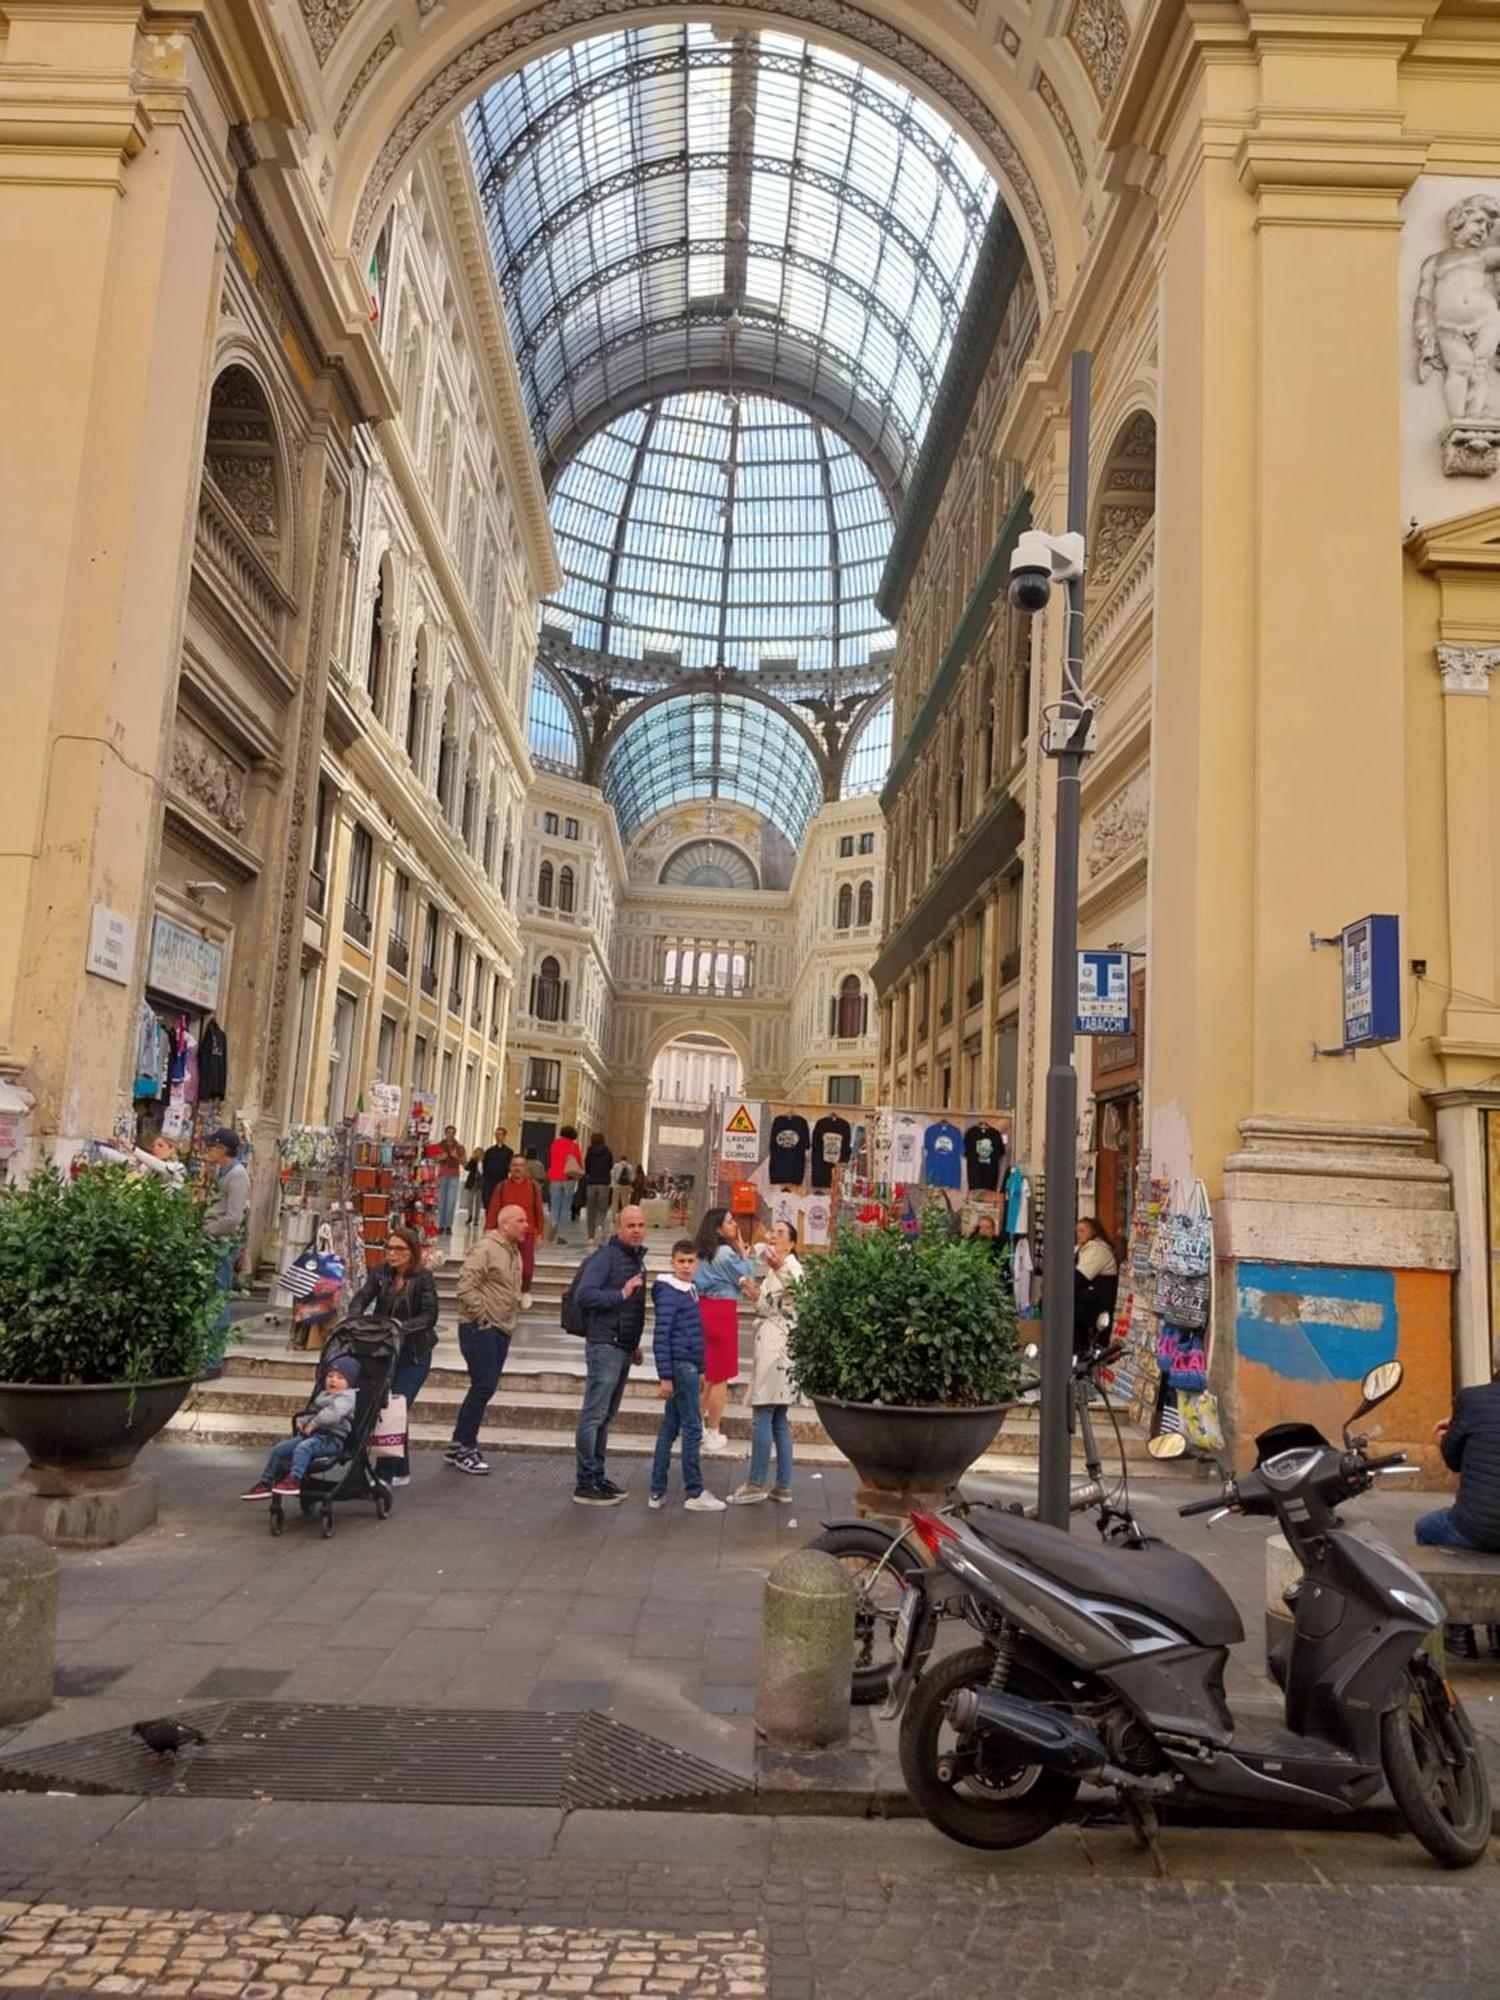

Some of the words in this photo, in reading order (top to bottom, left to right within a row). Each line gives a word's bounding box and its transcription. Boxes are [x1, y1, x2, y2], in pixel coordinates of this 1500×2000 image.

[1084, 954, 1122, 997] T
[1080, 1017, 1125, 1032] TABACCHI
[726, 1135, 757, 1143] LAVORI
